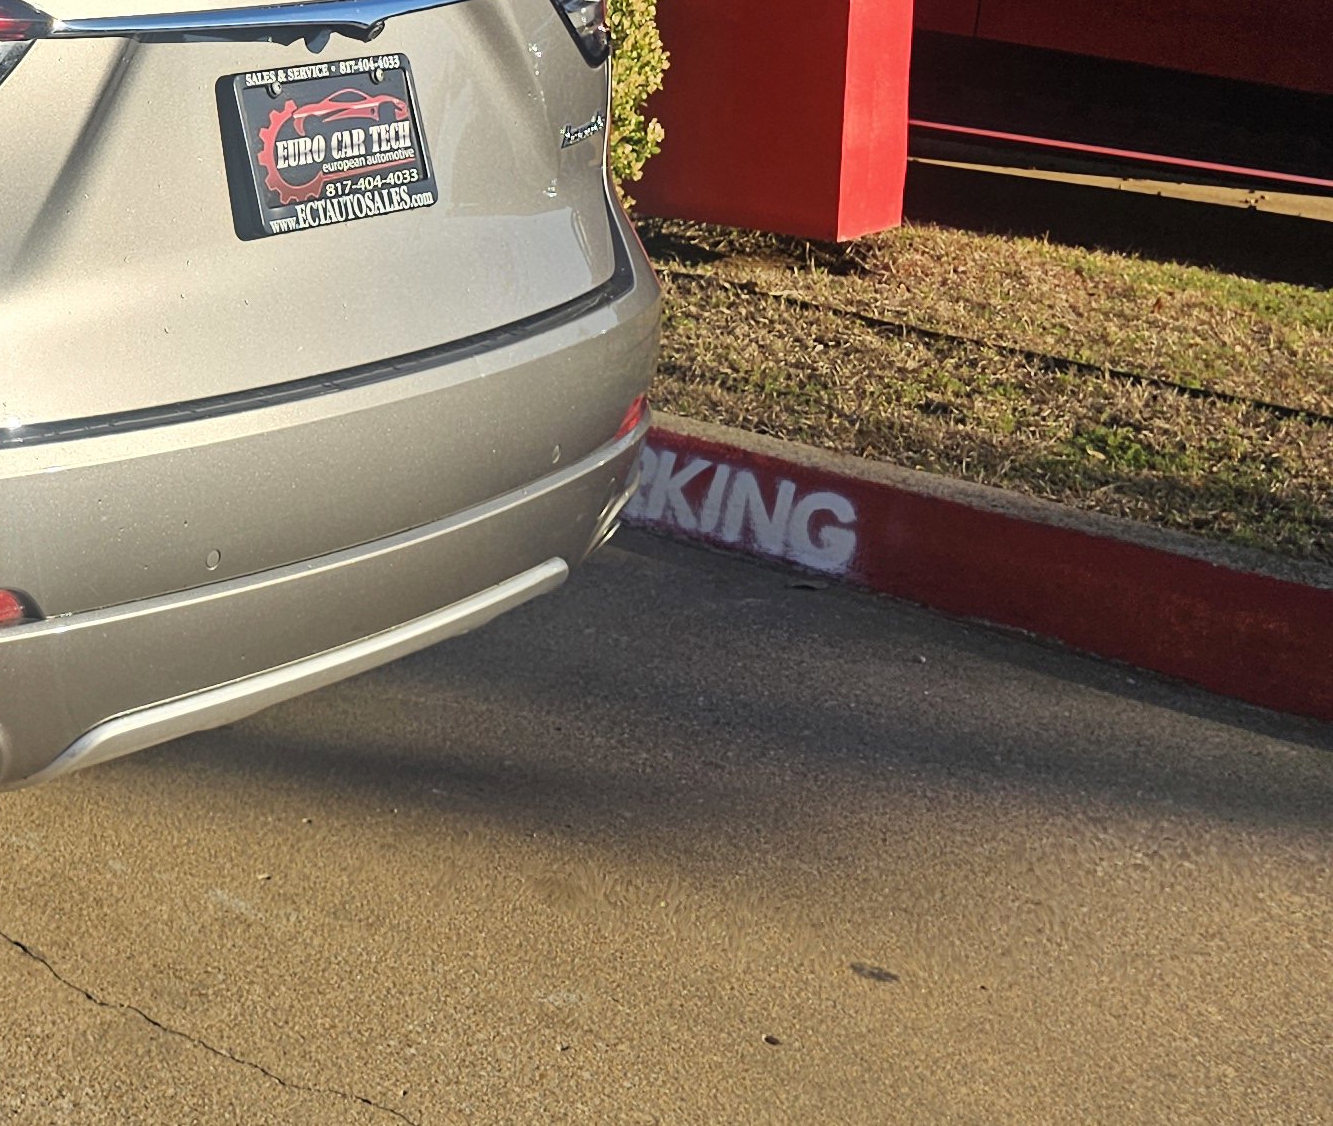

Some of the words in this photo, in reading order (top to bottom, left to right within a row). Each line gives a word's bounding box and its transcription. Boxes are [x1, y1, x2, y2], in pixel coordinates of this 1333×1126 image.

[245, 69, 276, 86] SALES
[277, 69, 286, 82] &
[287, 64, 330, 81] SERVICE
[339, 54, 400, 75] 817-404-4033
[276, 135, 326, 169] EURO
[330, 128, 366, 159] CAR
[369, 121, 412, 153] TECH
[322, 157, 366, 173] european
[366, 148, 415, 165] automotive
[325, 168, 418, 197] 817-404-4033
[269, 185, 434, 234] www.ECTAUTOSALES.com
